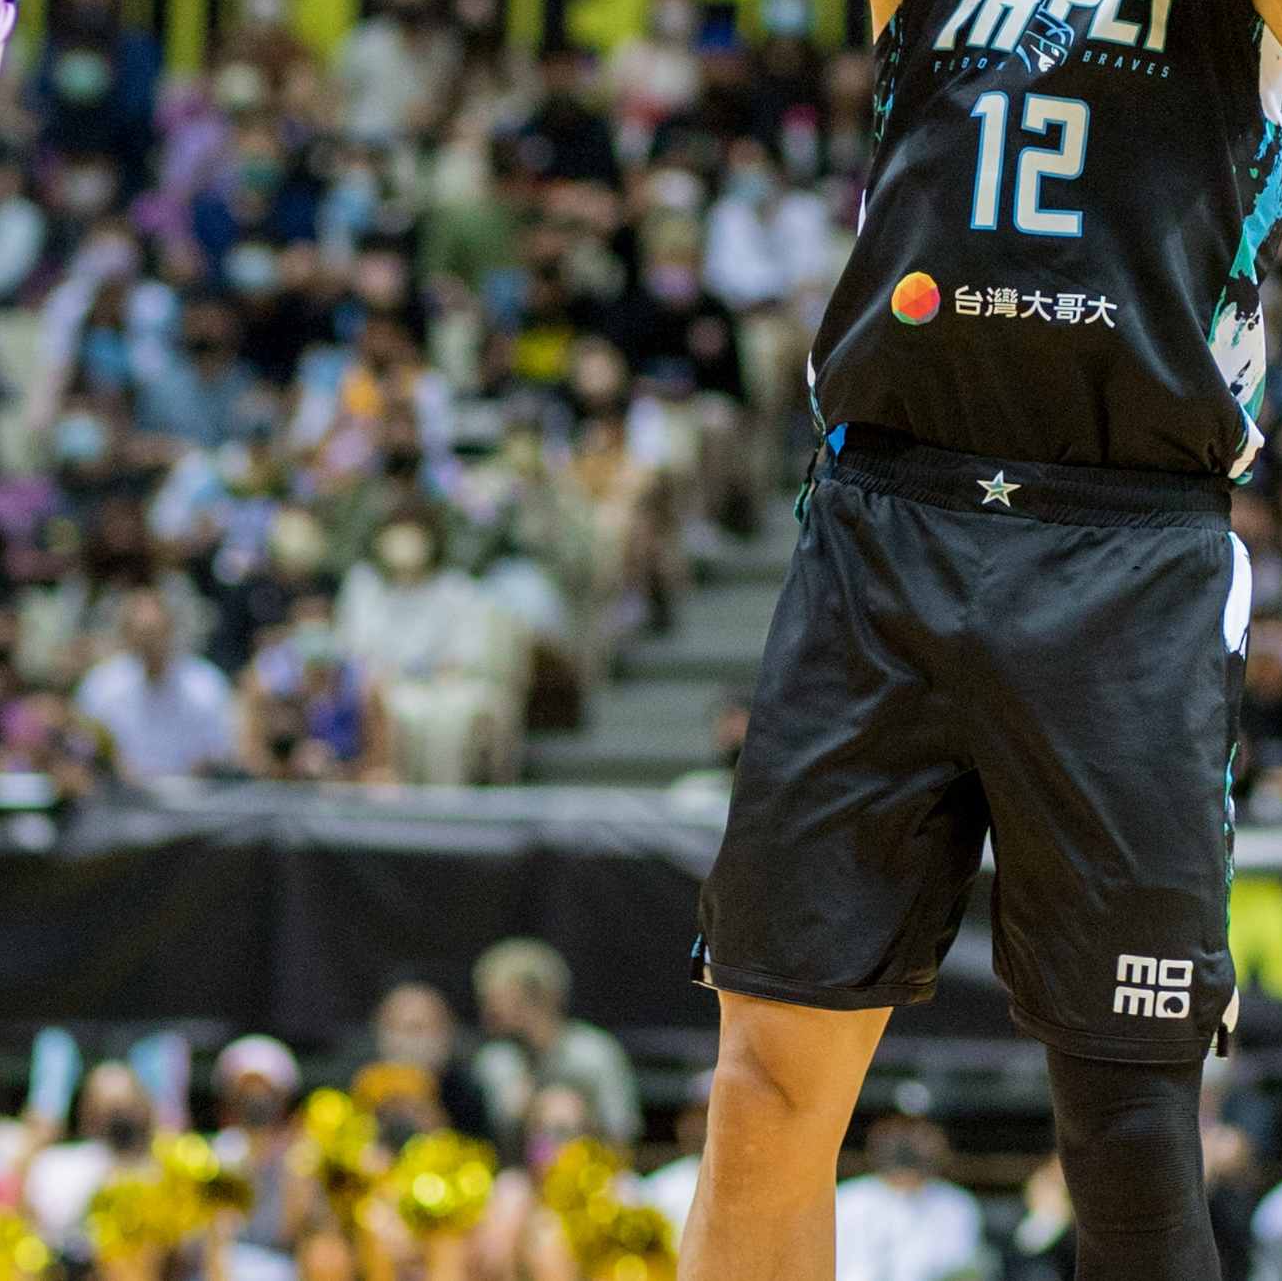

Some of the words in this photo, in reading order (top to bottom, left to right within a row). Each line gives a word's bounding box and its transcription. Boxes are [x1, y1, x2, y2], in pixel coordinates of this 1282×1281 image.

[1082, 50, 1170, 79] BRAVES
[969, 90, 1091, 238] 12
[954, 284, 1119, 329] 台灣大哥大
